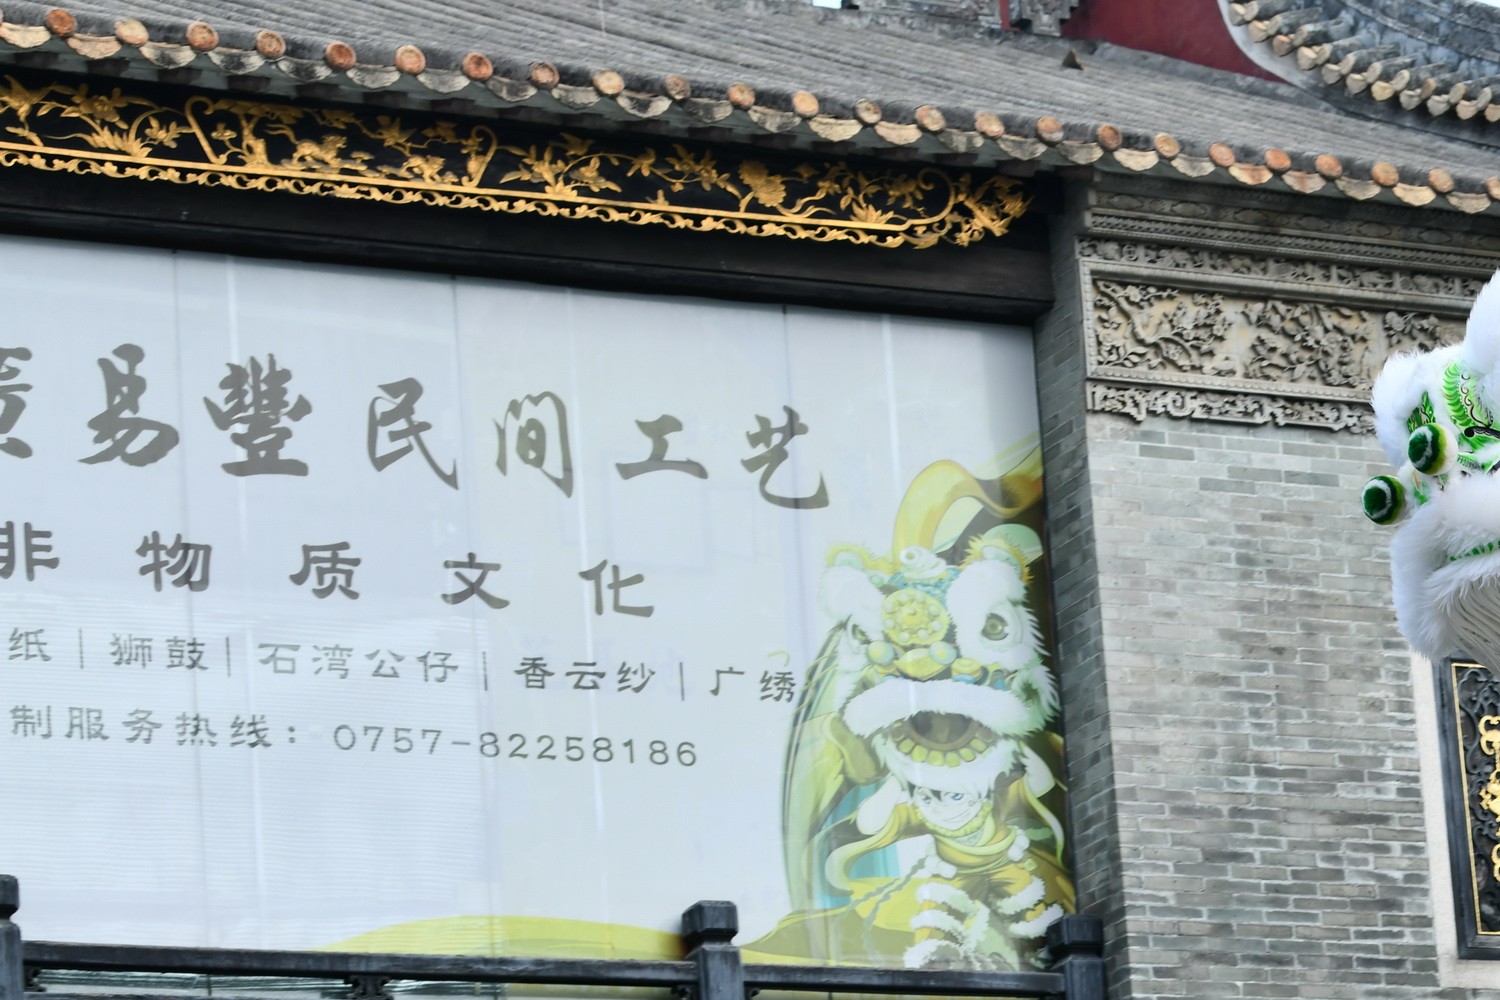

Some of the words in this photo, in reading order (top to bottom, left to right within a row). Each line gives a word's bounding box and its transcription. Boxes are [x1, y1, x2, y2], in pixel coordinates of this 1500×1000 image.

[0, 520, 654, 617] 非物质文化
